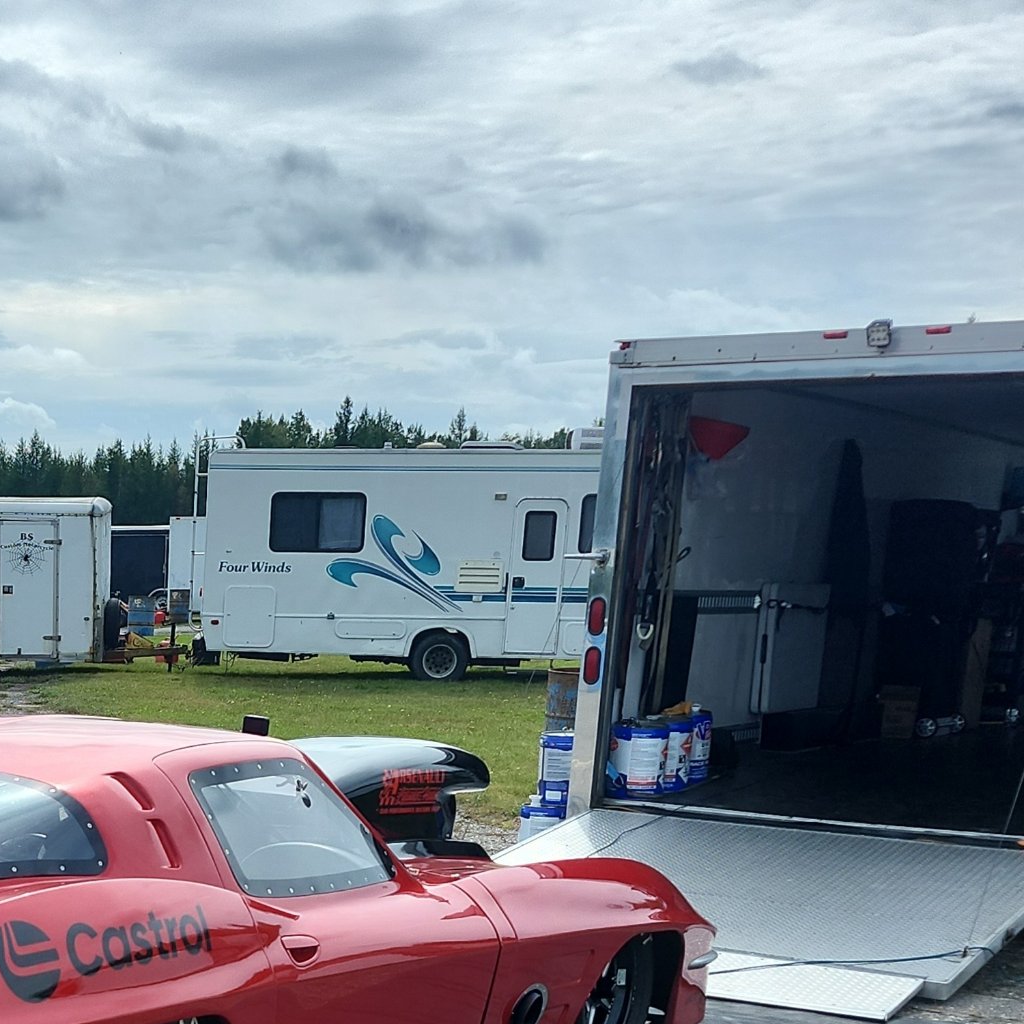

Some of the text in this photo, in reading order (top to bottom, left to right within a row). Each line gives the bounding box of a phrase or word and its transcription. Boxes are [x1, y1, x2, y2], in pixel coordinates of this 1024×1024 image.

[20, 532, 34, 541] BS
[218, 561, 292, 573] Four Winds
[66, 904, 213, 977] Castrol
